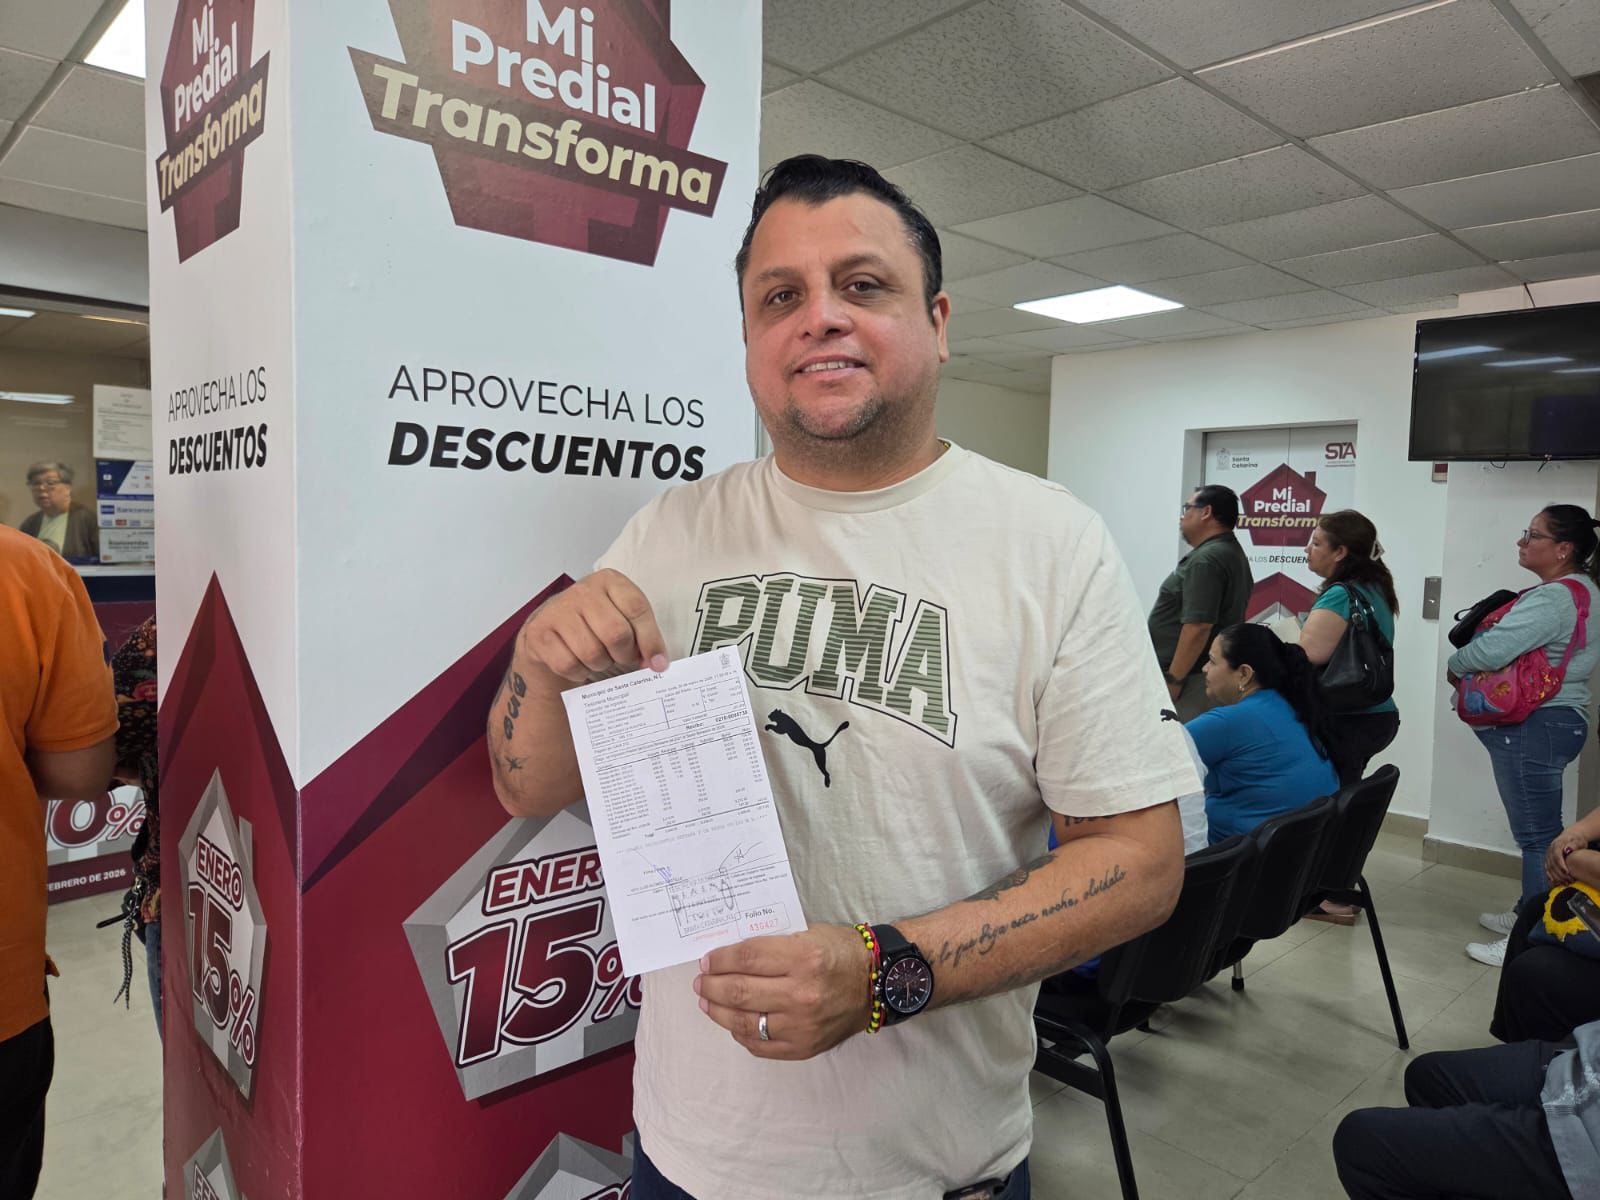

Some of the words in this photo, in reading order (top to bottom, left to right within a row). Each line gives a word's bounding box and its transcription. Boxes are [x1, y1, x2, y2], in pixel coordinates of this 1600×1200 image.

[192, 0, 215, 65] Mi
[526, 0, 594, 63] Mi
[174, 21, 238, 133] Predial
[452, 19, 656, 133] Predial
[160, 78, 264, 201] Transforma
[373, 63, 713, 205] Transforma
[168, 375, 237, 423] APROVECHA
[240, 366, 266, 406] LOS
[388, 364, 634, 422] APROVECHA
[645, 393, 705, 428] LOS
[169, 422, 268, 475] DESCUENTOS
[388, 421, 706, 482] DESCUENTOS
[1237, 513, 1321, 529] Transform
[1254, 498, 1311, 513] Predial
[1272, 486, 1292, 501] Mi
[1268, 555, 1309, 564] DESCUEN
[614, 682, 628, 690] Santa
[690, 572, 957, 748] PUMA
[45, 791, 147, 848] 0%
[47, 876, 88, 892] EBRERO
[88, 873, 102, 883] DE
[103, 868, 127, 881] 2026
[196, 834, 244, 911] ENERO
[482, 845, 604, 916] ENER
[744, 909, 762, 919] Folio
[188, 882, 255, 1067] 15%
[445, 897, 642, 1068] 15%
